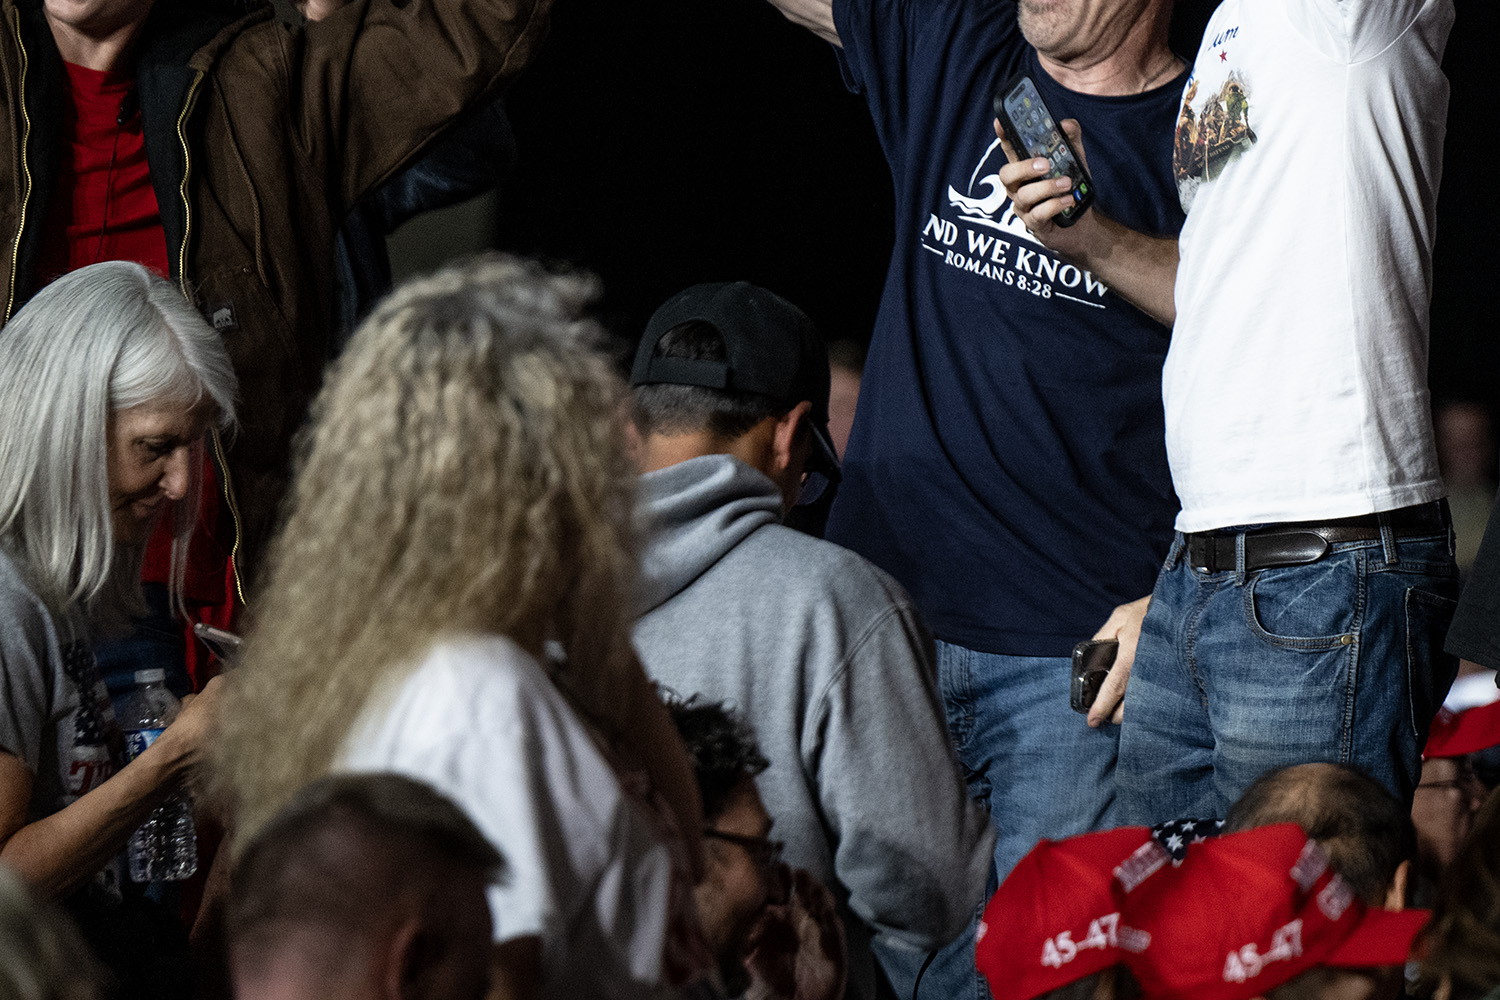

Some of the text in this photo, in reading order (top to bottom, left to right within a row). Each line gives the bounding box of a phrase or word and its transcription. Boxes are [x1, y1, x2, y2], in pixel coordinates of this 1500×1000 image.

[921, 213, 1109, 298] ND WE KNOW
[944, 249, 1052, 299] ROMANS 8:28
[1041, 911, 1121, 969] 45-47
[1222, 918, 1304, 984] 45-47
